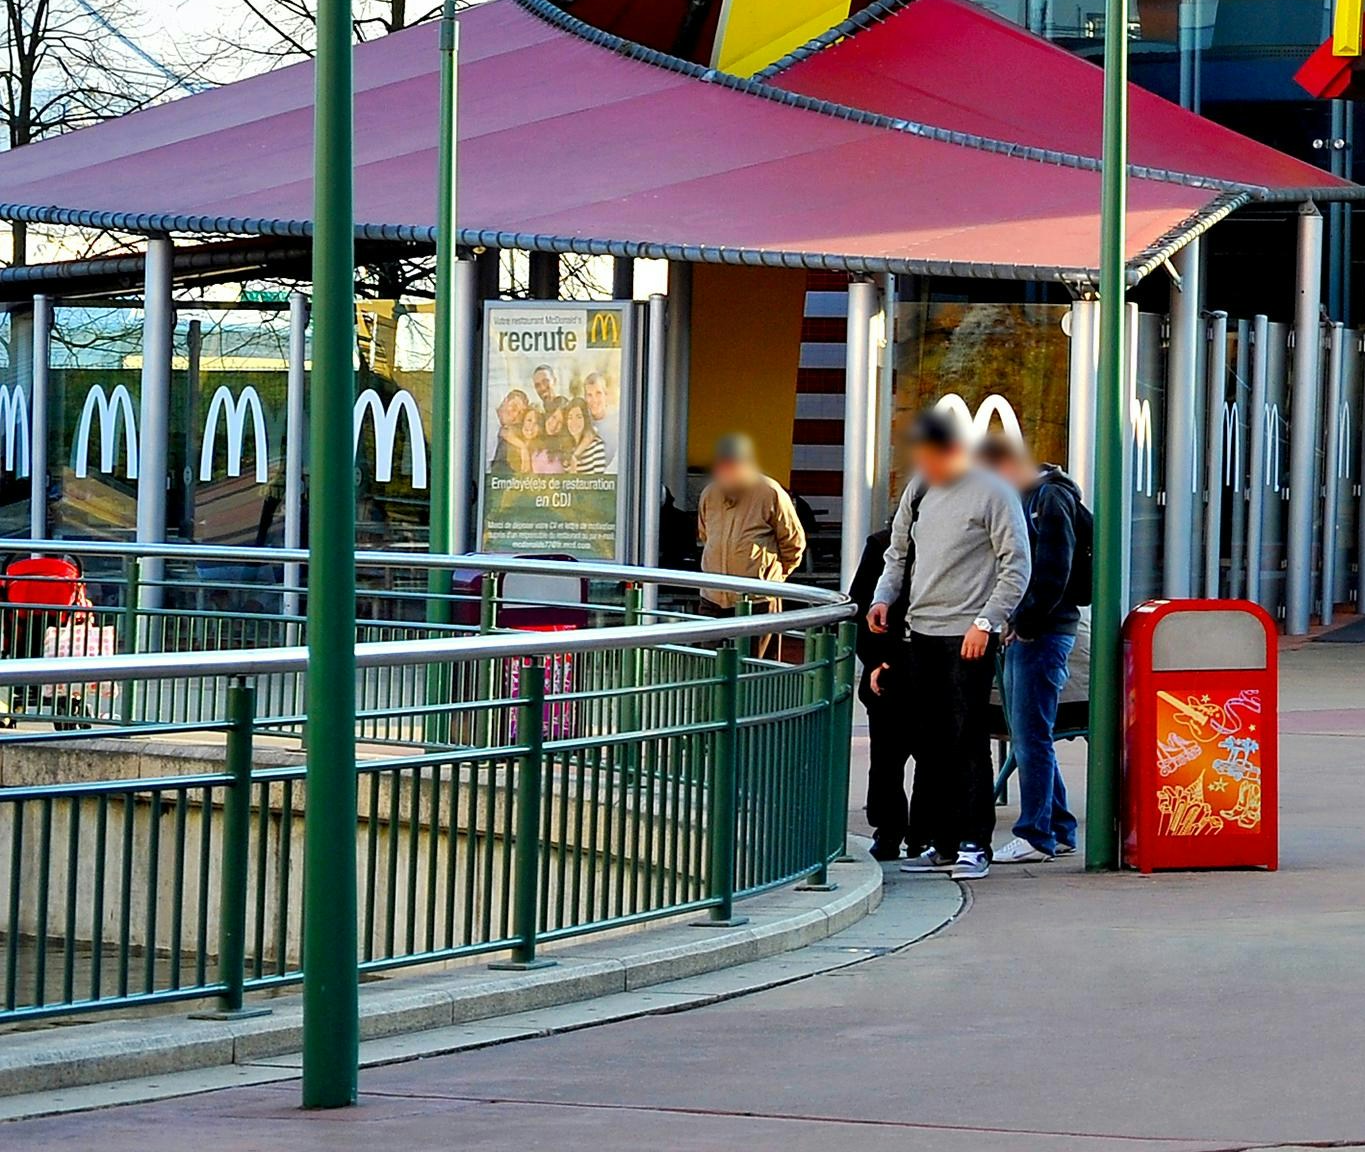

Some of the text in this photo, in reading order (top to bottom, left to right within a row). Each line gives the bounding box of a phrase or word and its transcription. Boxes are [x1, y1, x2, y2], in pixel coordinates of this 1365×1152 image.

[498, 326, 577, 351] recrute
[548, 477, 561, 490] de
[562, 478, 616, 490] restauration
[535, 492, 572, 508] en CDI
